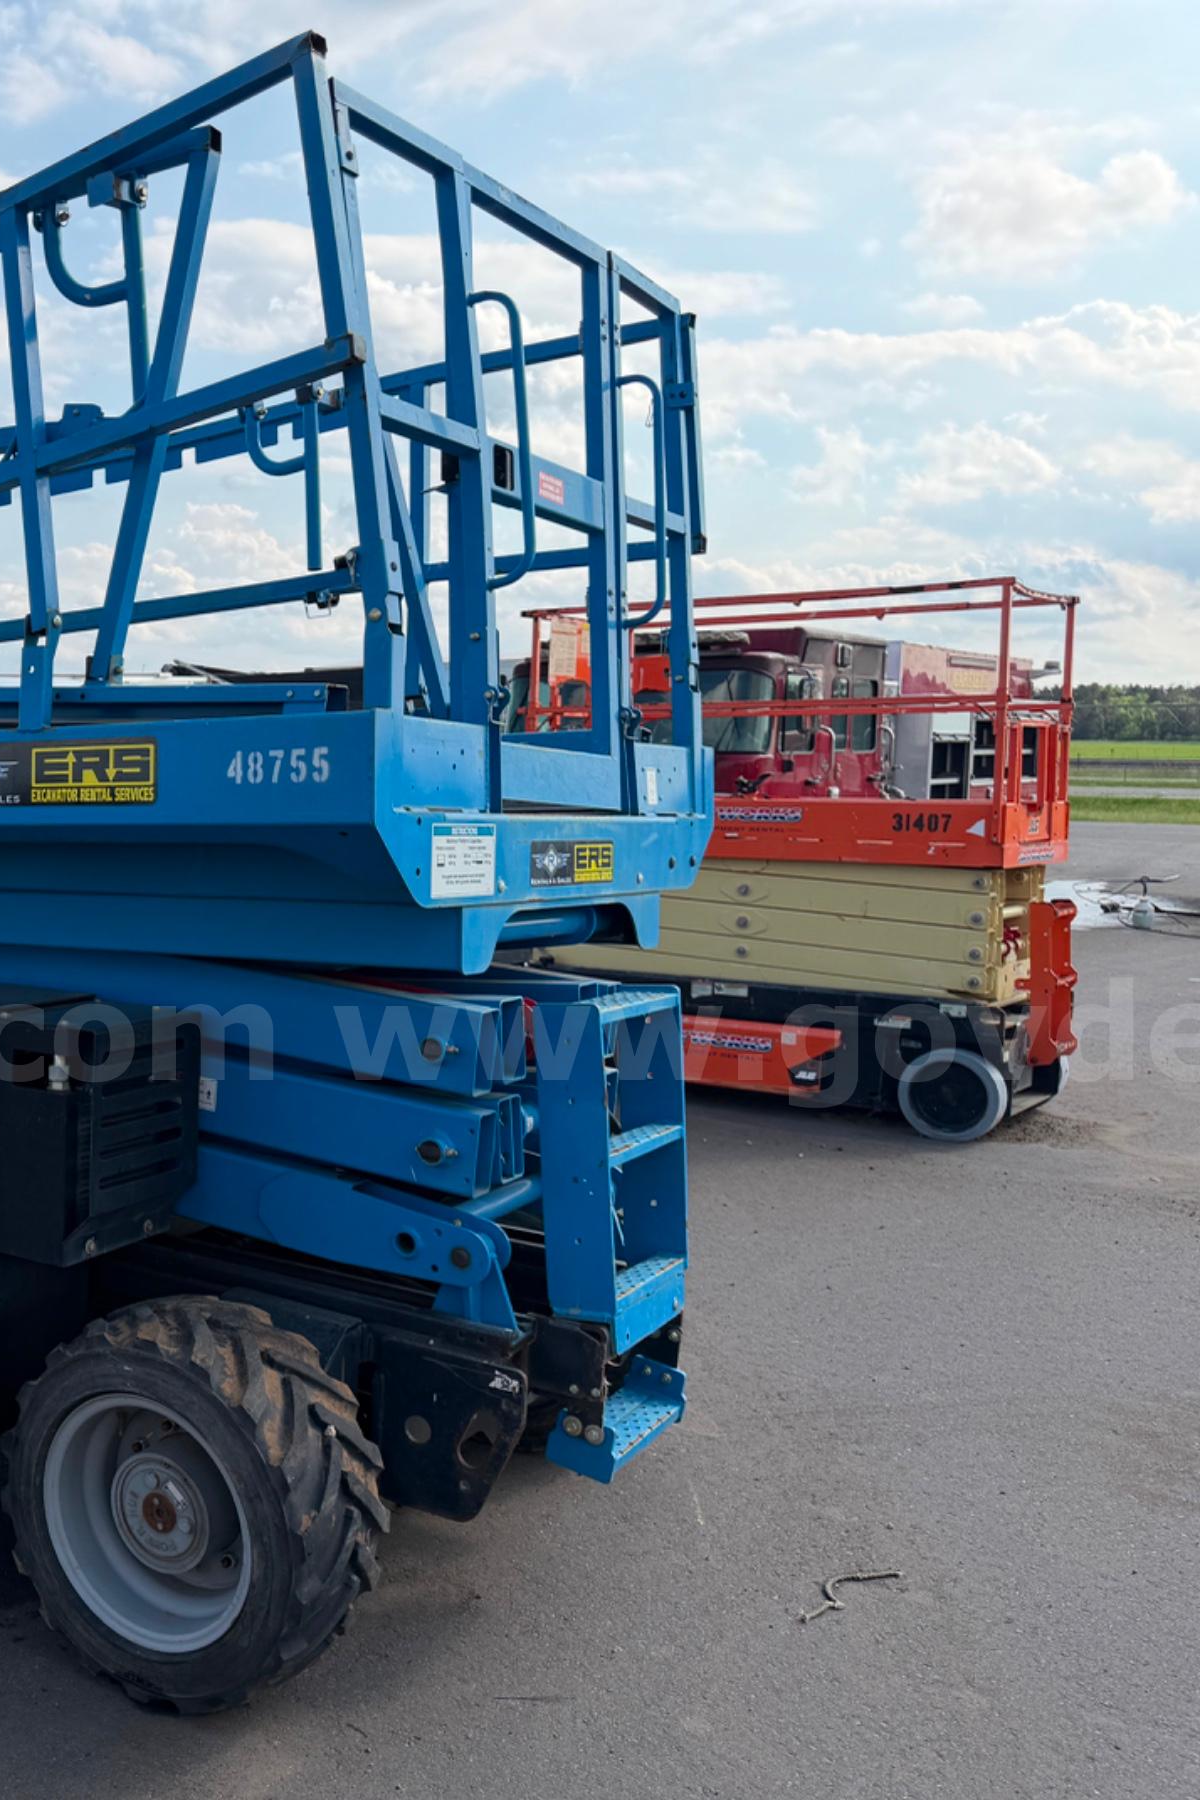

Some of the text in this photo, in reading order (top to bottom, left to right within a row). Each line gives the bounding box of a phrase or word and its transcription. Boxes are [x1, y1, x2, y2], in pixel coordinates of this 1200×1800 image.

[34, 747, 152, 785] ERS
[227, 746, 330, 784] 48755
[31, 786, 154, 803] EXCAVATOR RENTAL SERVICES
[892, 814, 952, 833] 31407
